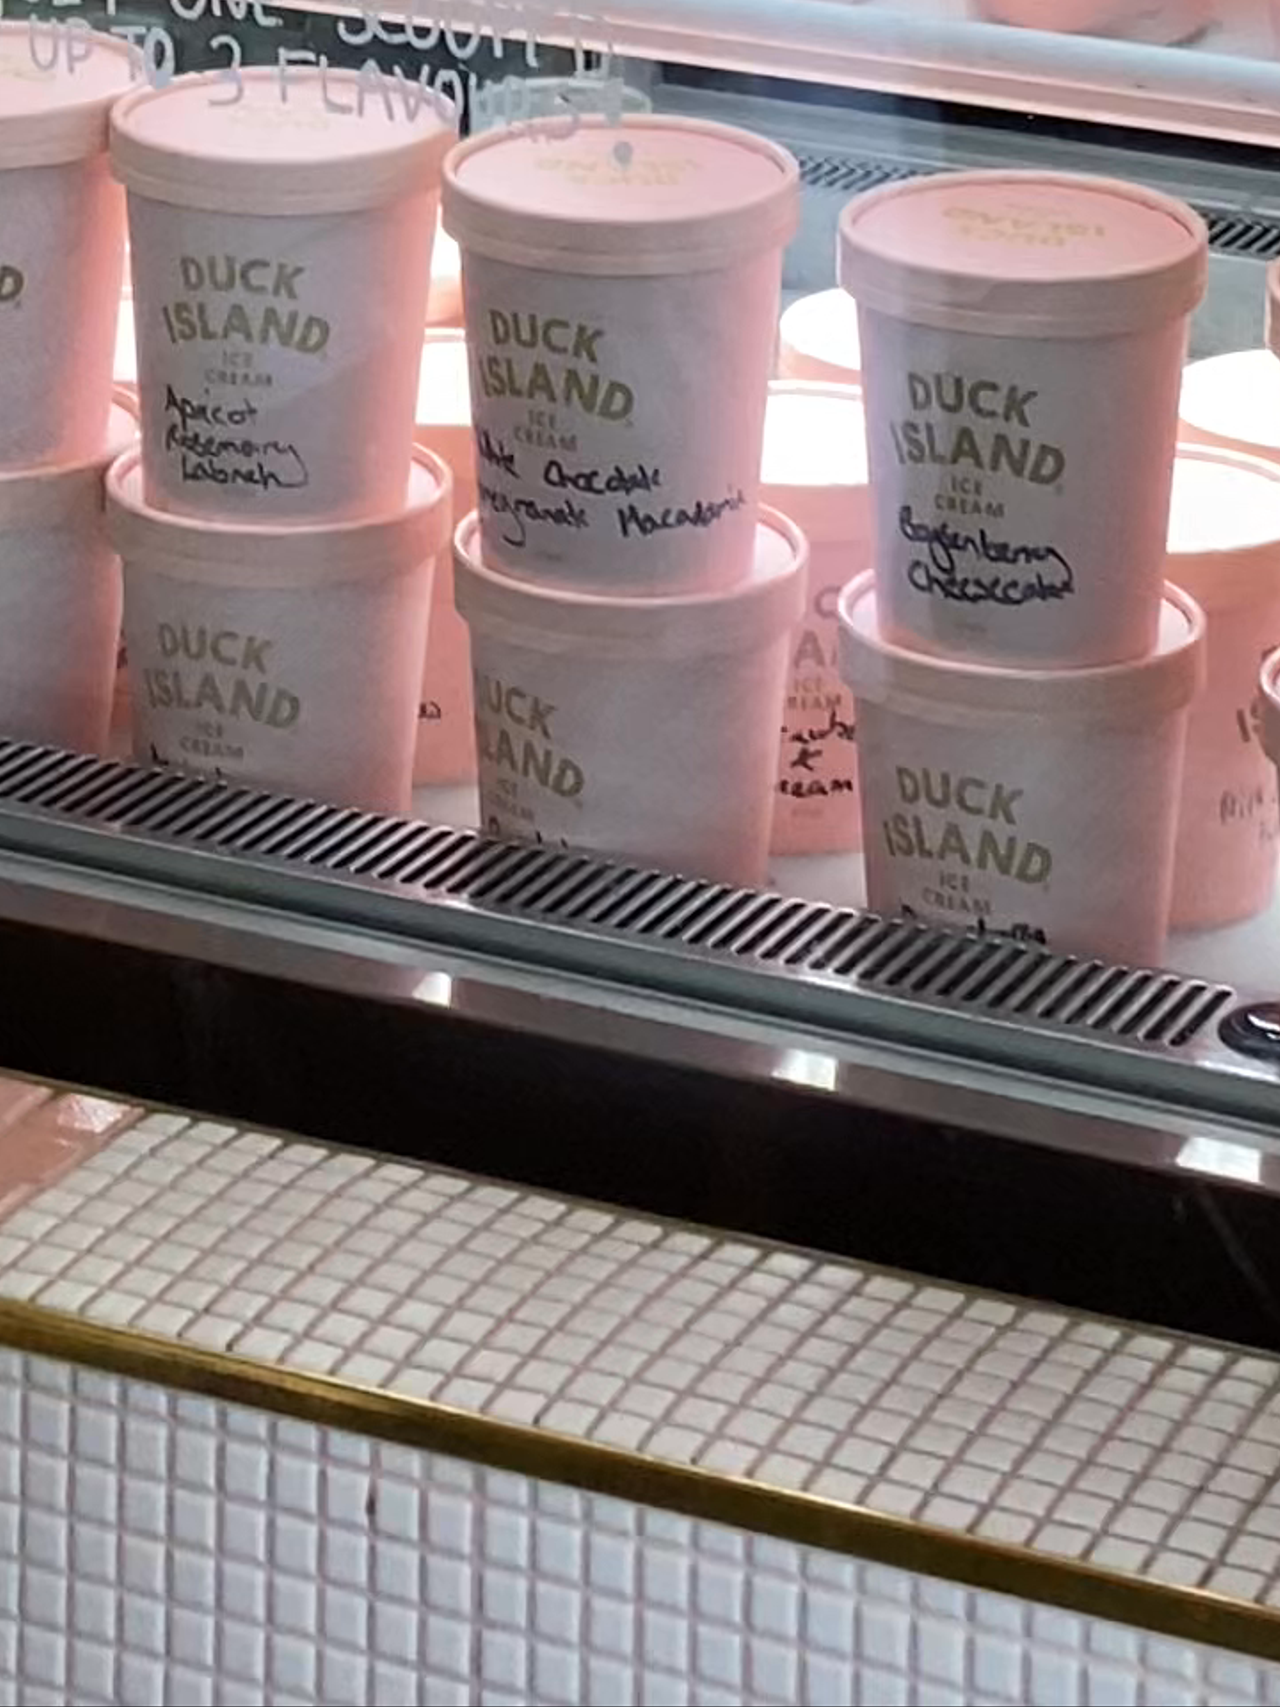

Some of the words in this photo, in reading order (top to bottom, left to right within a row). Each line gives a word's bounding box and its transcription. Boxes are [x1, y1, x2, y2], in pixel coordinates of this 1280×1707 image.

[29, 12, 94, 75] UP
[179, 253, 307, 302] DUCK
[163, 303, 332, 357] ISLAND
[486, 306, 608, 364] DUCK
[164, 383, 258, 431] Apricot
[474, 356, 637, 427] ISLAND
[906, 369, 1039, 428] DUCK
[889, 419, 1067, 488] ISLAND
[933, 493, 1006, 519] CREAM
[156, 621, 275, 675] DUCK
[142, 666, 302, 730] ISLAND
[894, 765, 1025, 826] DUCK
[883, 818, 1054, 886] ISLAND
